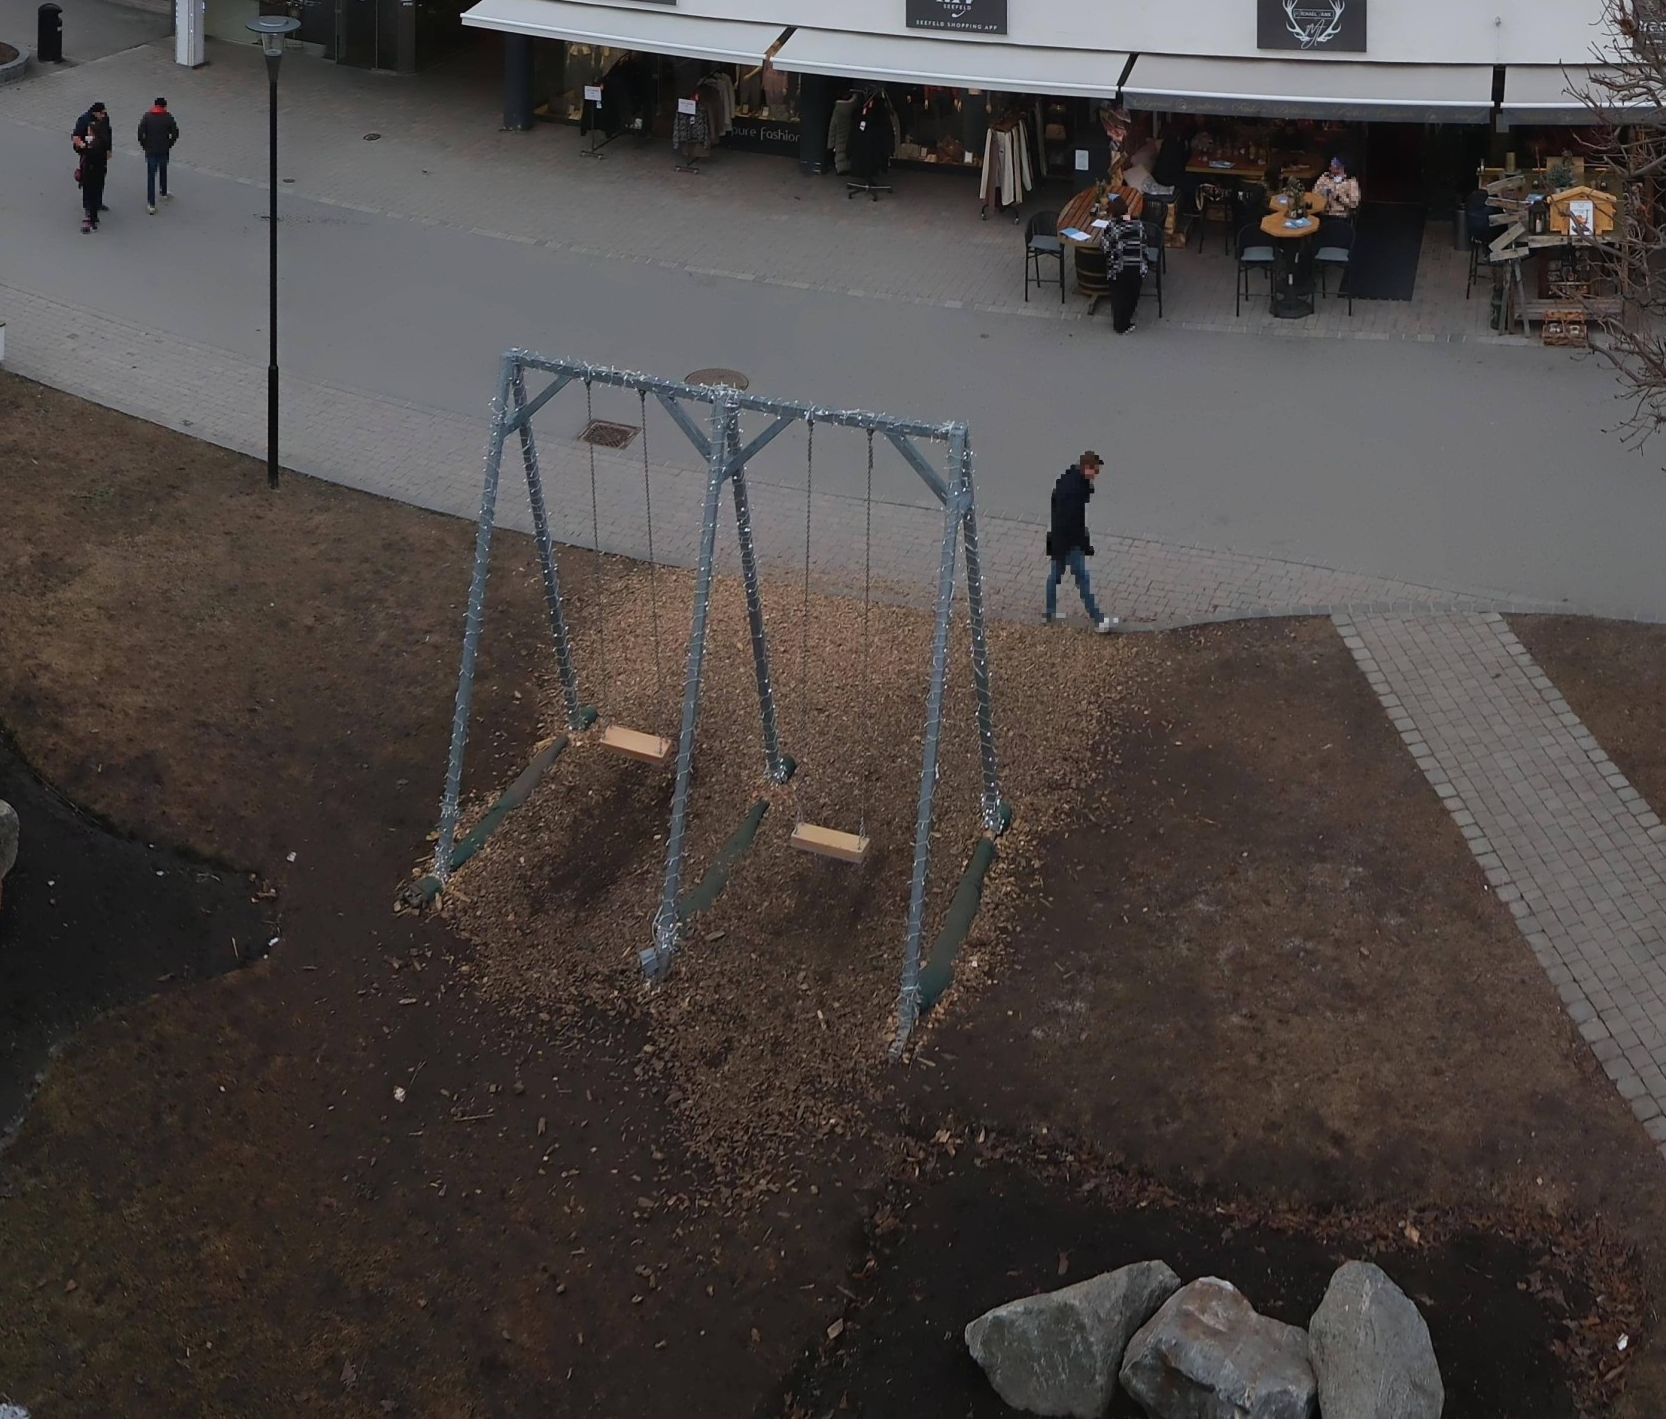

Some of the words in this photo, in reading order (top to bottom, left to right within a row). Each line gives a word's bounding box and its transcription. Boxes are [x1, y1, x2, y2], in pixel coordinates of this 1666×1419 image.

[943, 3, 972, 11] SEEFELD
[916, 19, 944, 27] SEEFELD
[947, 21, 982, 30] SHOPPING
